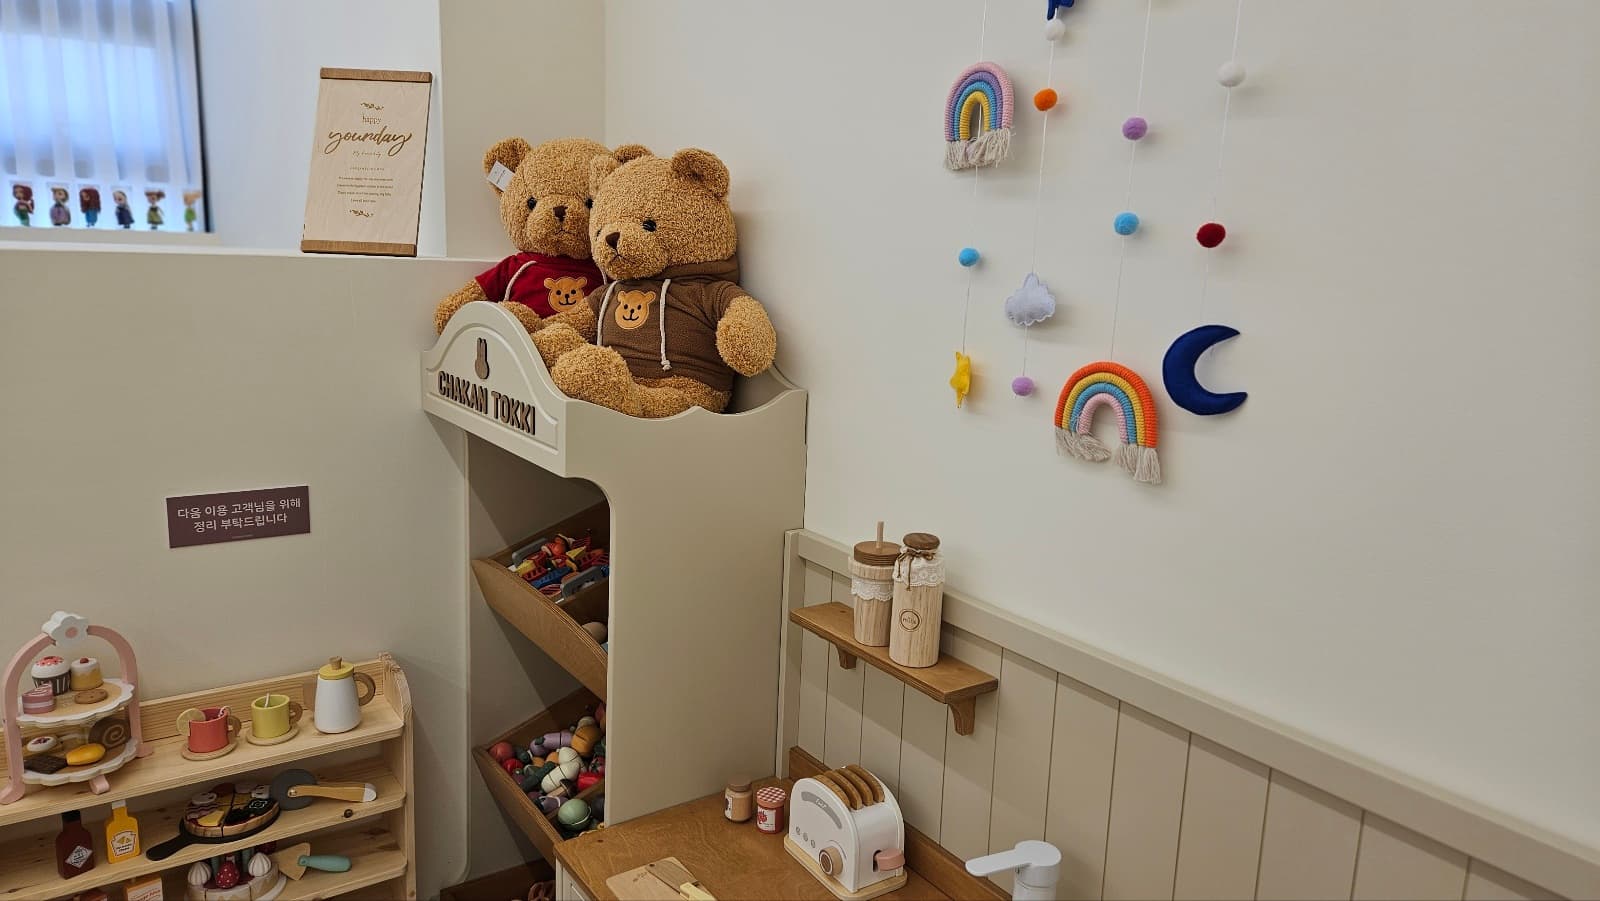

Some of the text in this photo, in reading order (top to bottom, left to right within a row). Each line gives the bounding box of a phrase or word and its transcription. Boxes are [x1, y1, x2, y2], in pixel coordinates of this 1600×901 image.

[438, 370, 536, 436] CHAKAN TOKKI
[177, 498, 301, 519] 다음 이용 고객님을 위해
[193, 513, 288, 533] 정리 부탁드립니다
